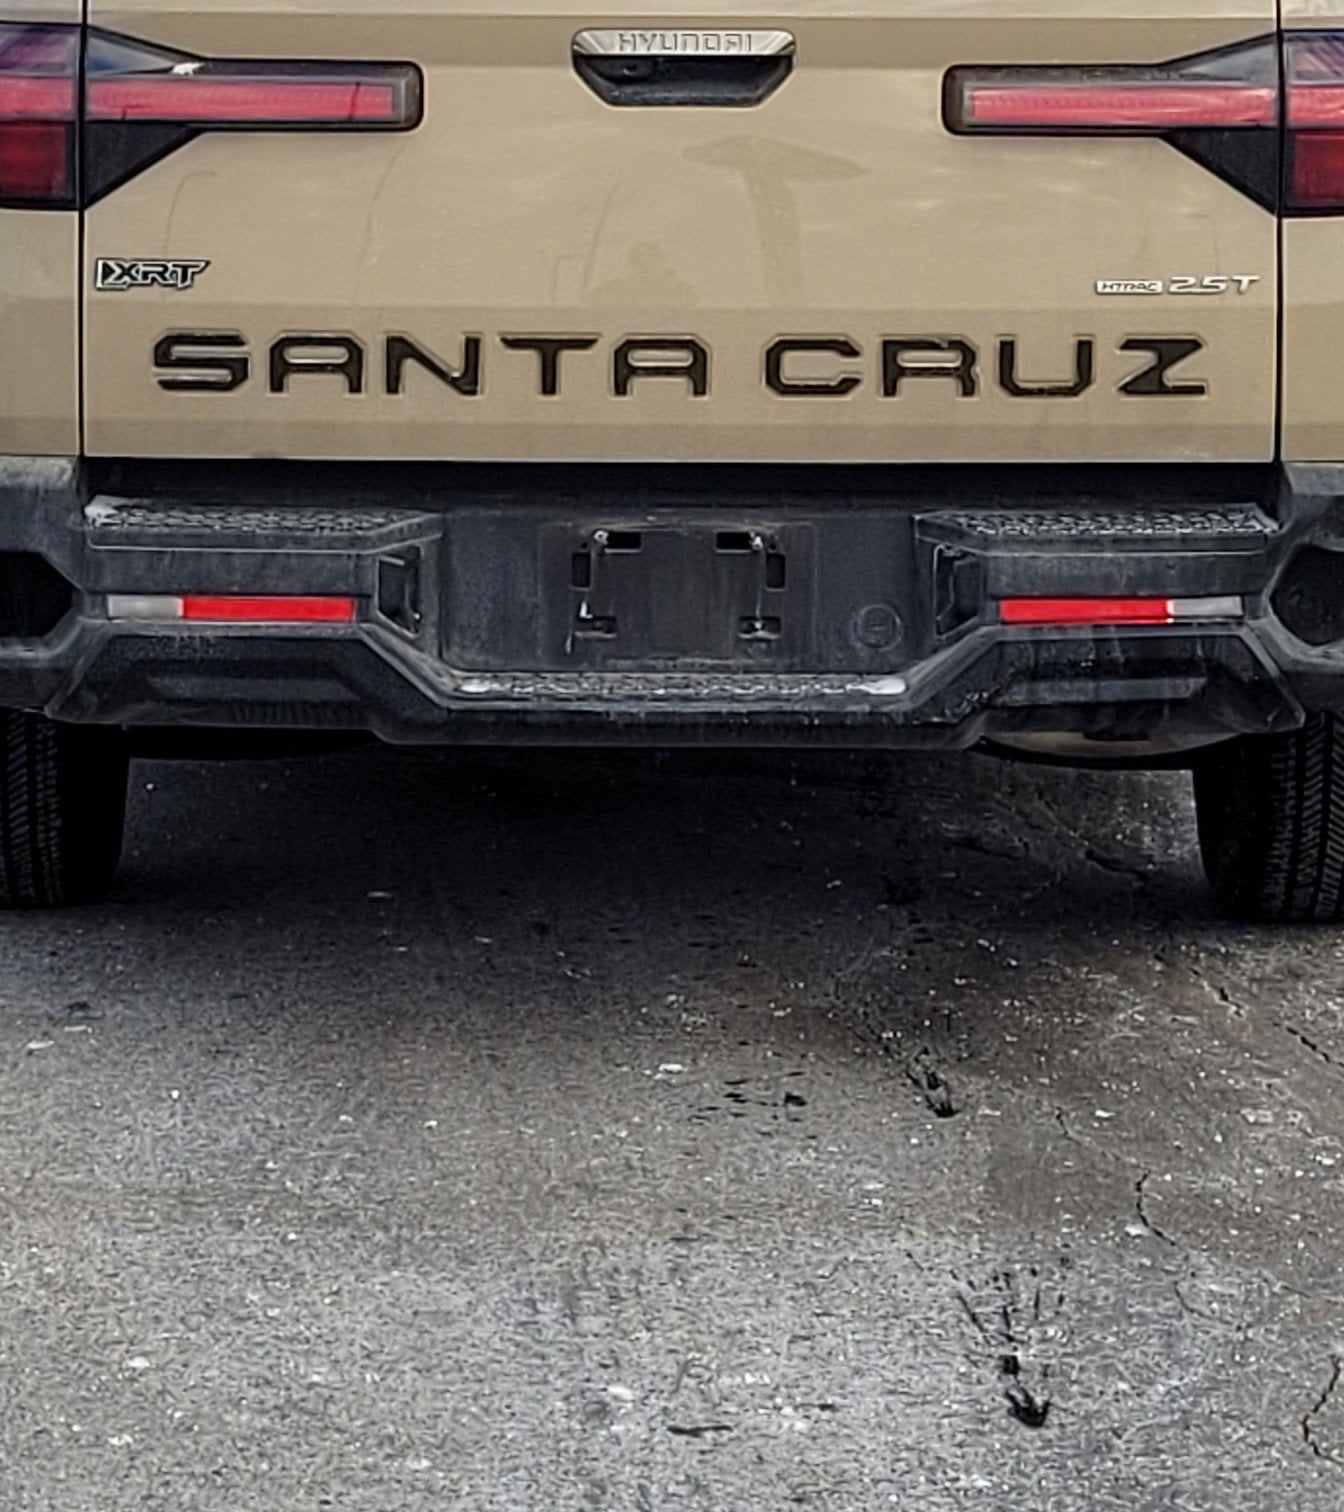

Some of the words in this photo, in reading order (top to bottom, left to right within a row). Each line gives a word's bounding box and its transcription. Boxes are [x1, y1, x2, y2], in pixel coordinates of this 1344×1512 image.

[618, 33, 753, 53] HYUNDAI
[96, 258, 211, 290] XRT
[153, 334, 709, 397] SANTA
[764, 337, 1206, 398] CRUZ
